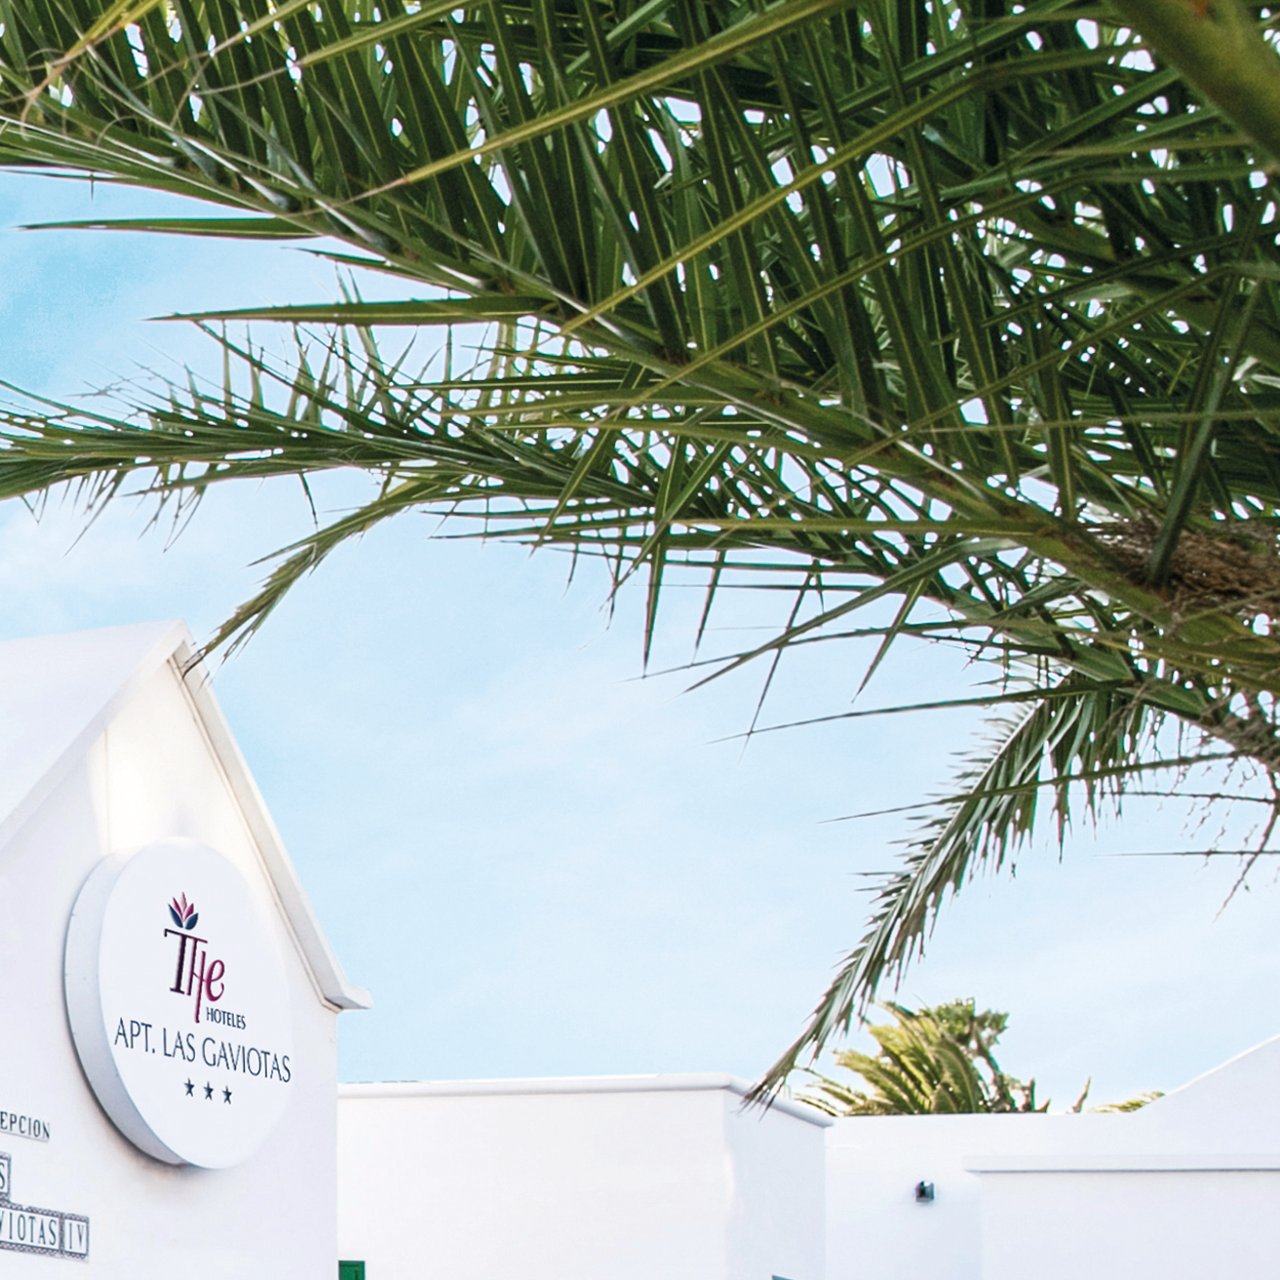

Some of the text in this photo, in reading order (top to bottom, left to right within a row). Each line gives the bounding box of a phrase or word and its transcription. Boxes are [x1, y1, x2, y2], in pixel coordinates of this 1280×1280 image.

[205, 1006, 247, 1031] HOTELES
[113, 1016, 291, 1083] APT. LAS GAVIOTAS
[68, 1222, 85, 1250] IV
